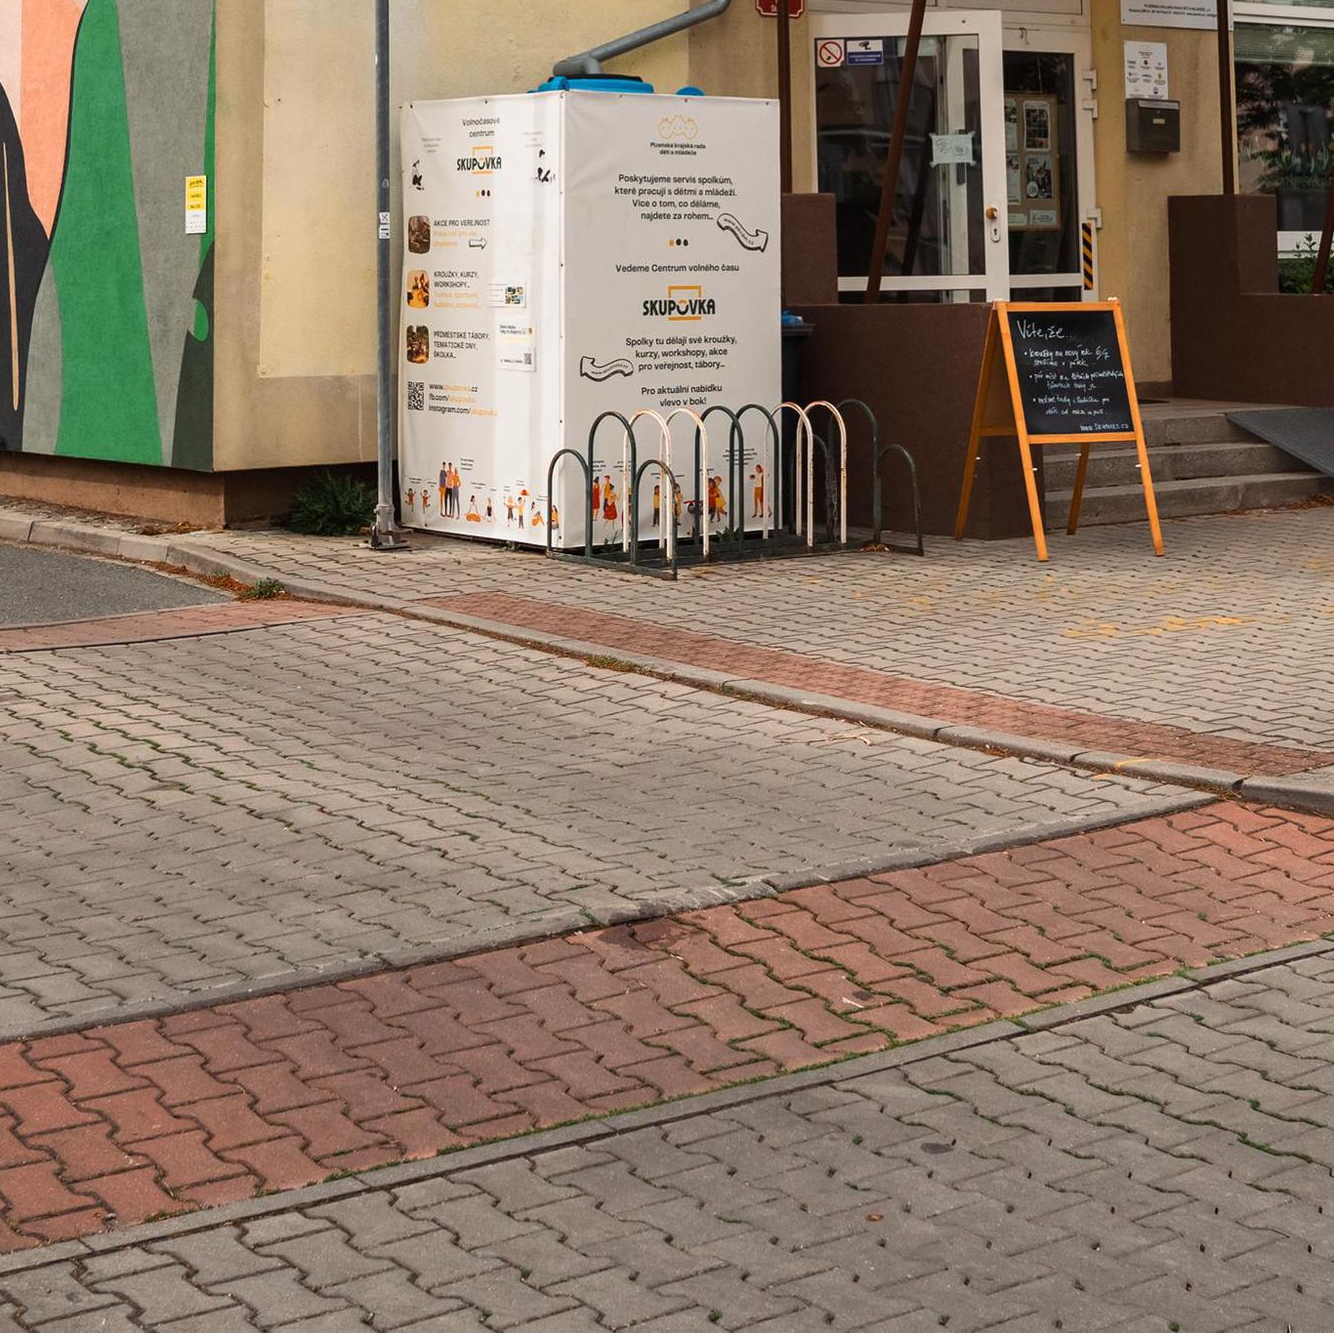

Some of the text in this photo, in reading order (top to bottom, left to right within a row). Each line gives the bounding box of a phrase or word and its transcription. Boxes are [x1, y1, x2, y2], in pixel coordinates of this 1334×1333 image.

[457, 157, 502, 171] SKUPOVKA
[619, 174, 671, 185] Poskytujeme
[698, 176, 733, 185] spolkům,
[615, 187, 636, 195] které
[638, 188, 666, 196] pracují
[674, 188, 697, 196] dětmi
[632, 199, 650, 208] Více
[690, 200, 720, 209] děláme,
[641, 212, 671, 221] najdete
[616, 265, 649, 273] Vedeme
[651, 264, 687, 272] Centrum
[689, 264, 720, 272] volného
[642, 298, 715, 316] SKUPOVKA
[626, 338, 653, 347] Spolky
[666, 337, 687, 346] dělají
[689, 336, 702, 344] své
[704, 335, 737, 345] kroužky,
[635, 348, 728, 358] kurzy, workshopy, akce
[638, 364, 653, 372] pro
[641, 385, 722, 395] Pro aktuální nabídku
[690, 397, 707, 405] bok!
